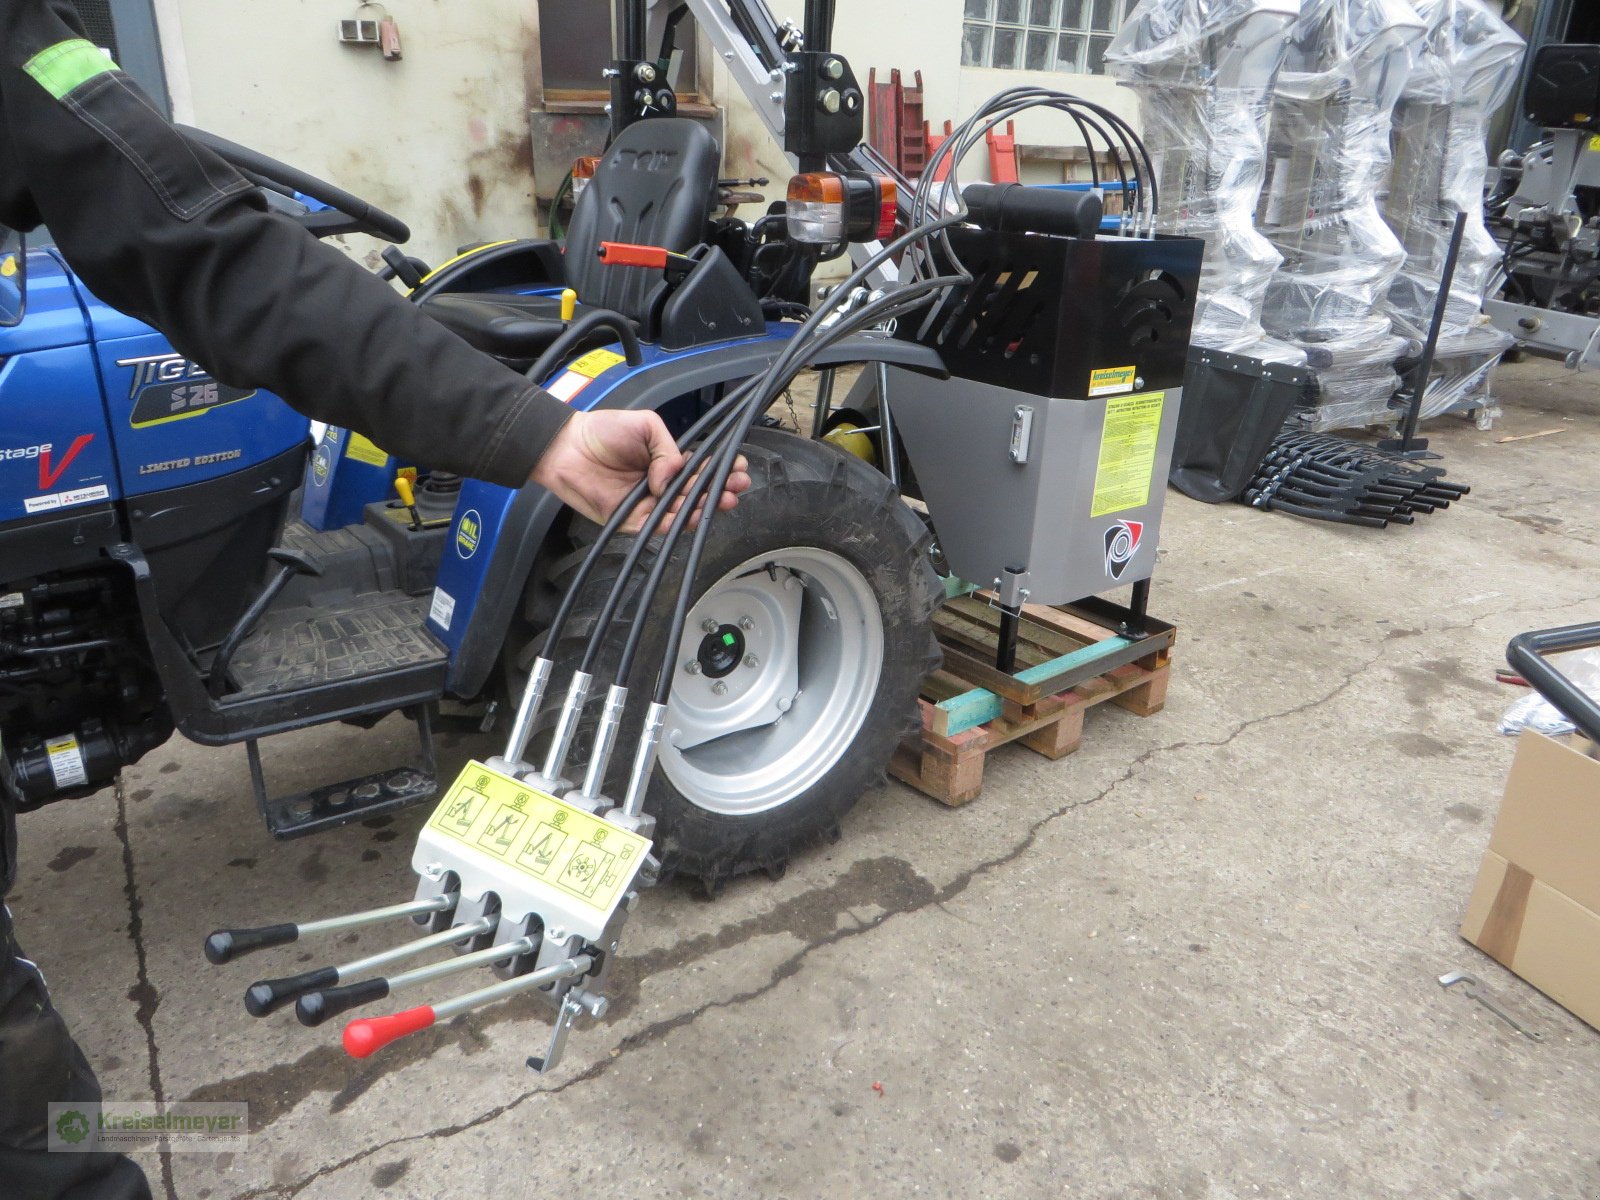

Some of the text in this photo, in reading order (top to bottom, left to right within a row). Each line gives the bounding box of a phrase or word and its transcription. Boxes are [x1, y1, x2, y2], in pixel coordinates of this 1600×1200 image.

[189, 383, 219, 406] 26
[38, 433, 96, 490] V
[140, 449, 241, 474] LIMITED EDITION
